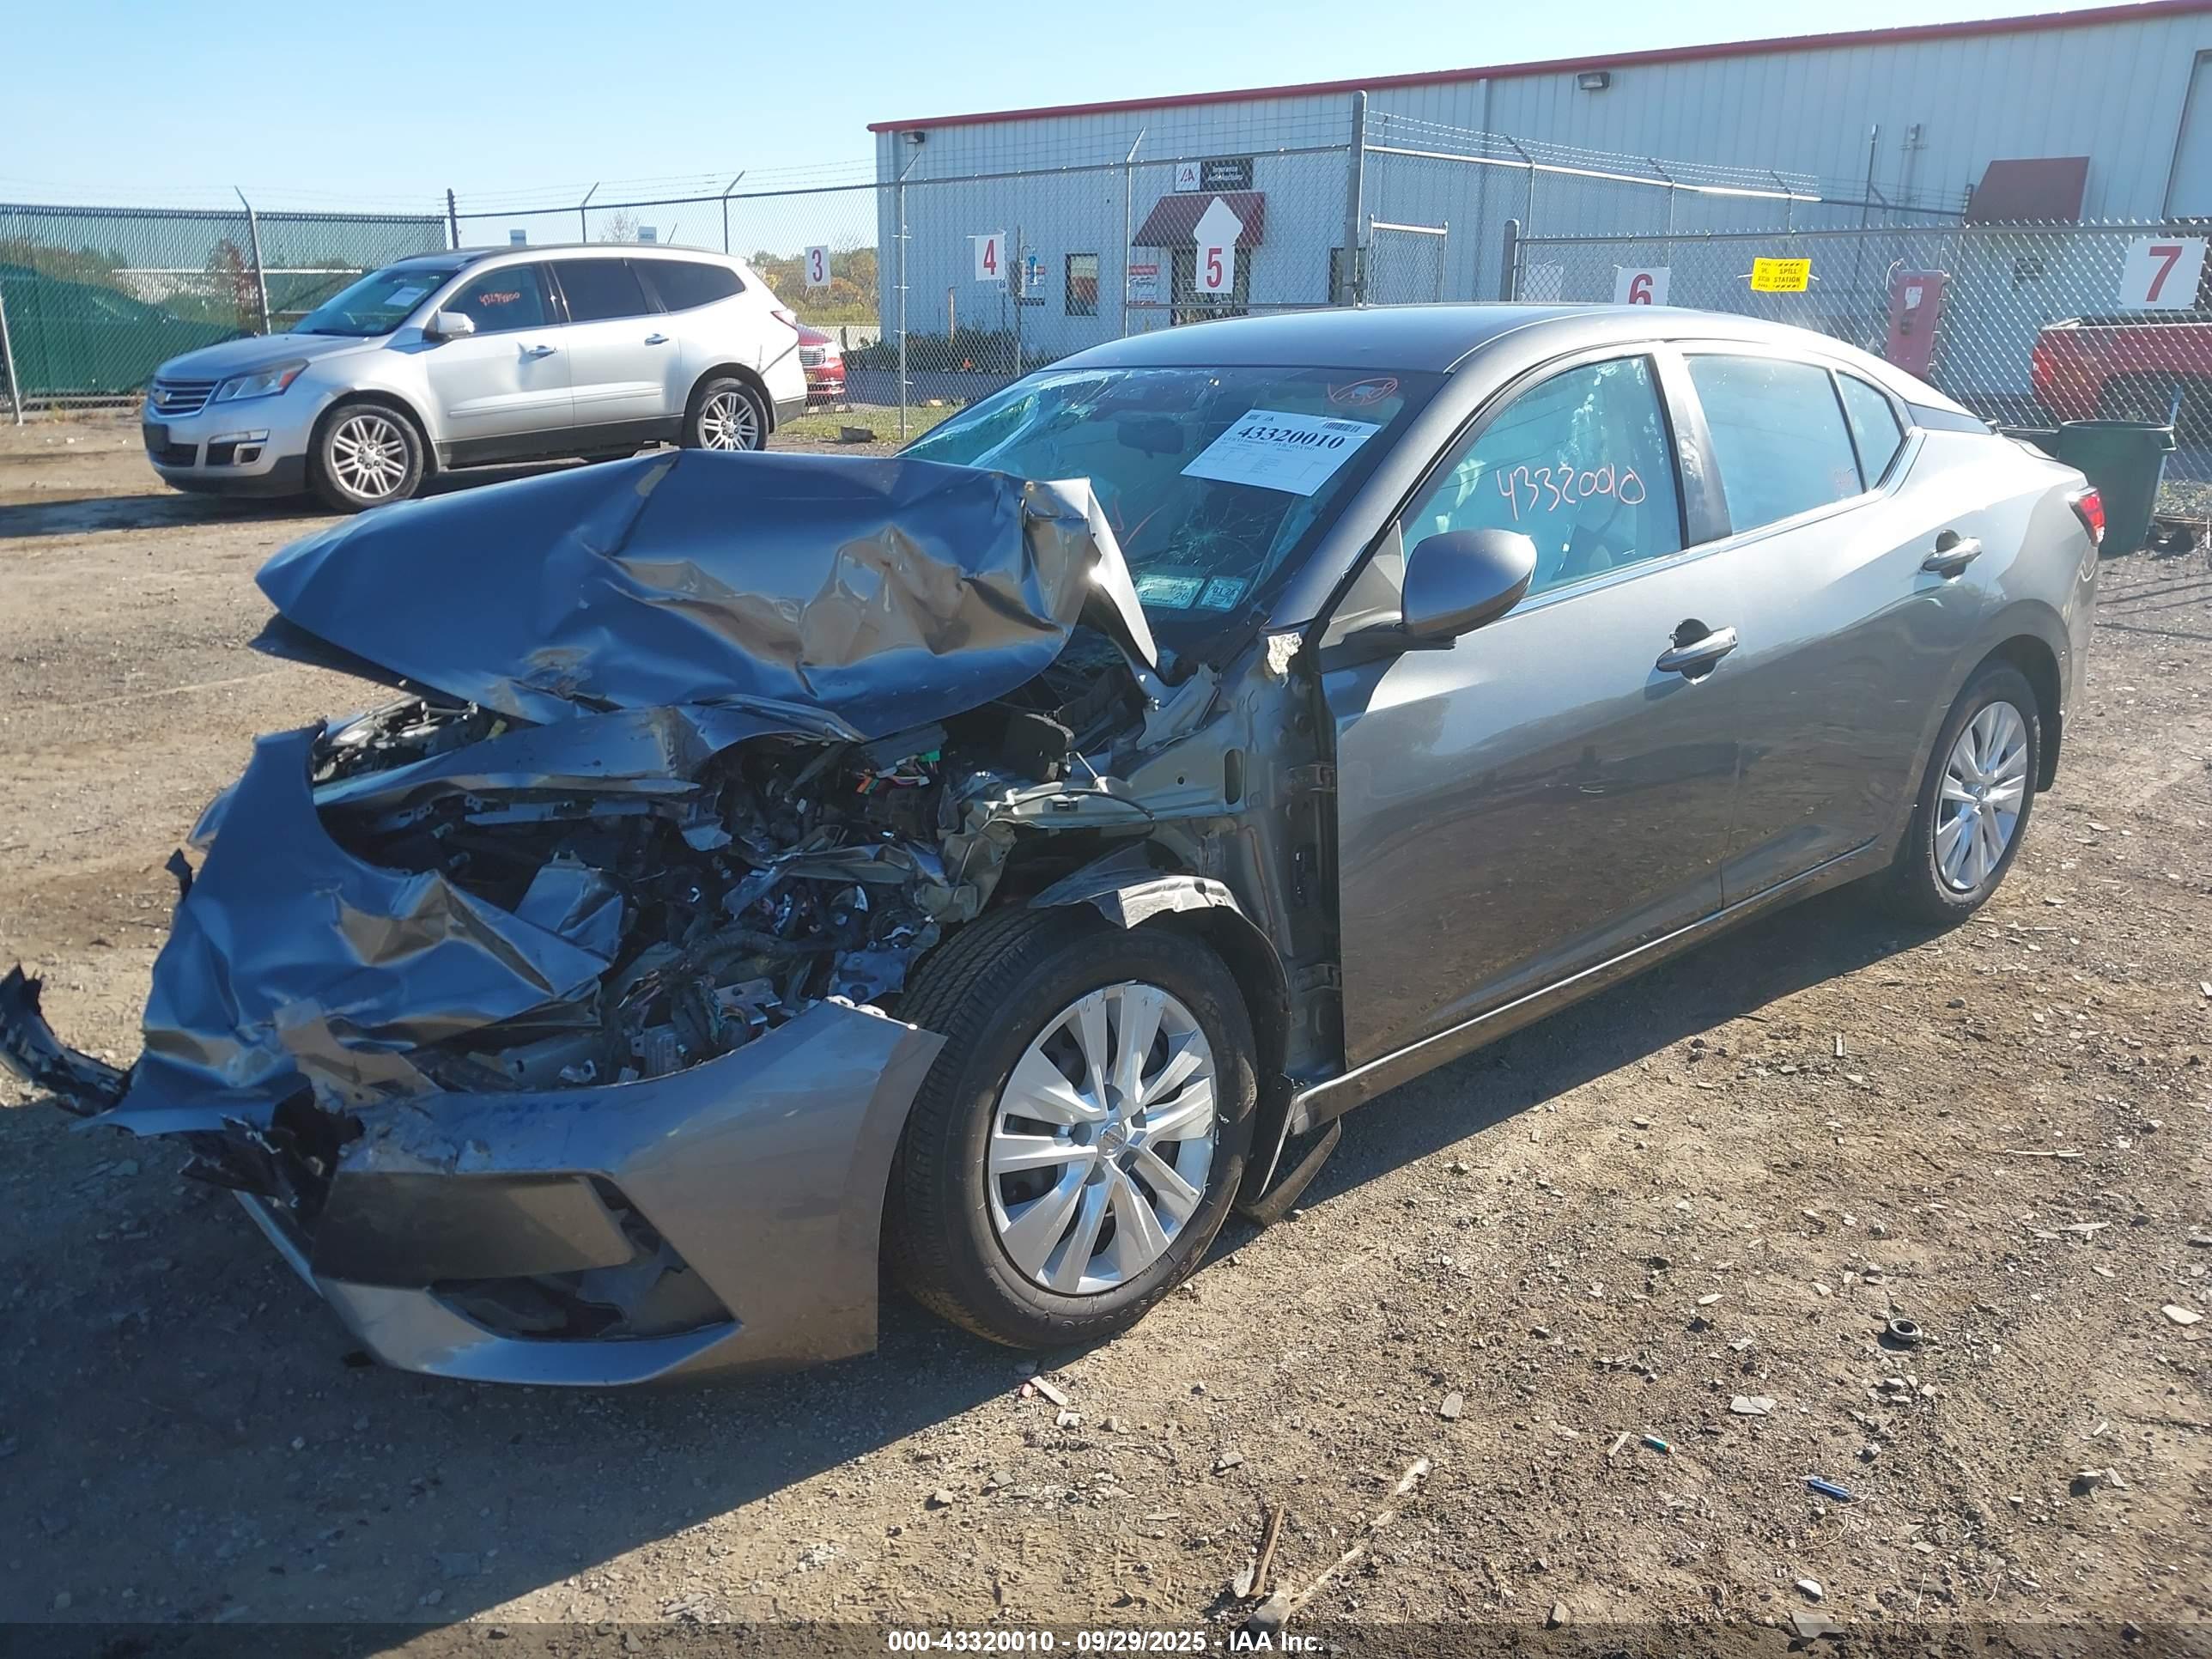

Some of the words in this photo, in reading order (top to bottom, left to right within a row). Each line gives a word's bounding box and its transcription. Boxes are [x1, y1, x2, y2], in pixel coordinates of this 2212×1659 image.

[811, 249, 823, 283] 3
[983, 239, 997, 276] 4
[1206, 247, 1223, 289] 5
[2146, 246, 2184, 302] 7
[1628, 273, 1653, 305] 6
[1237, 425, 1346, 449] 43320010
[1496, 463, 1646, 521] 43320010
